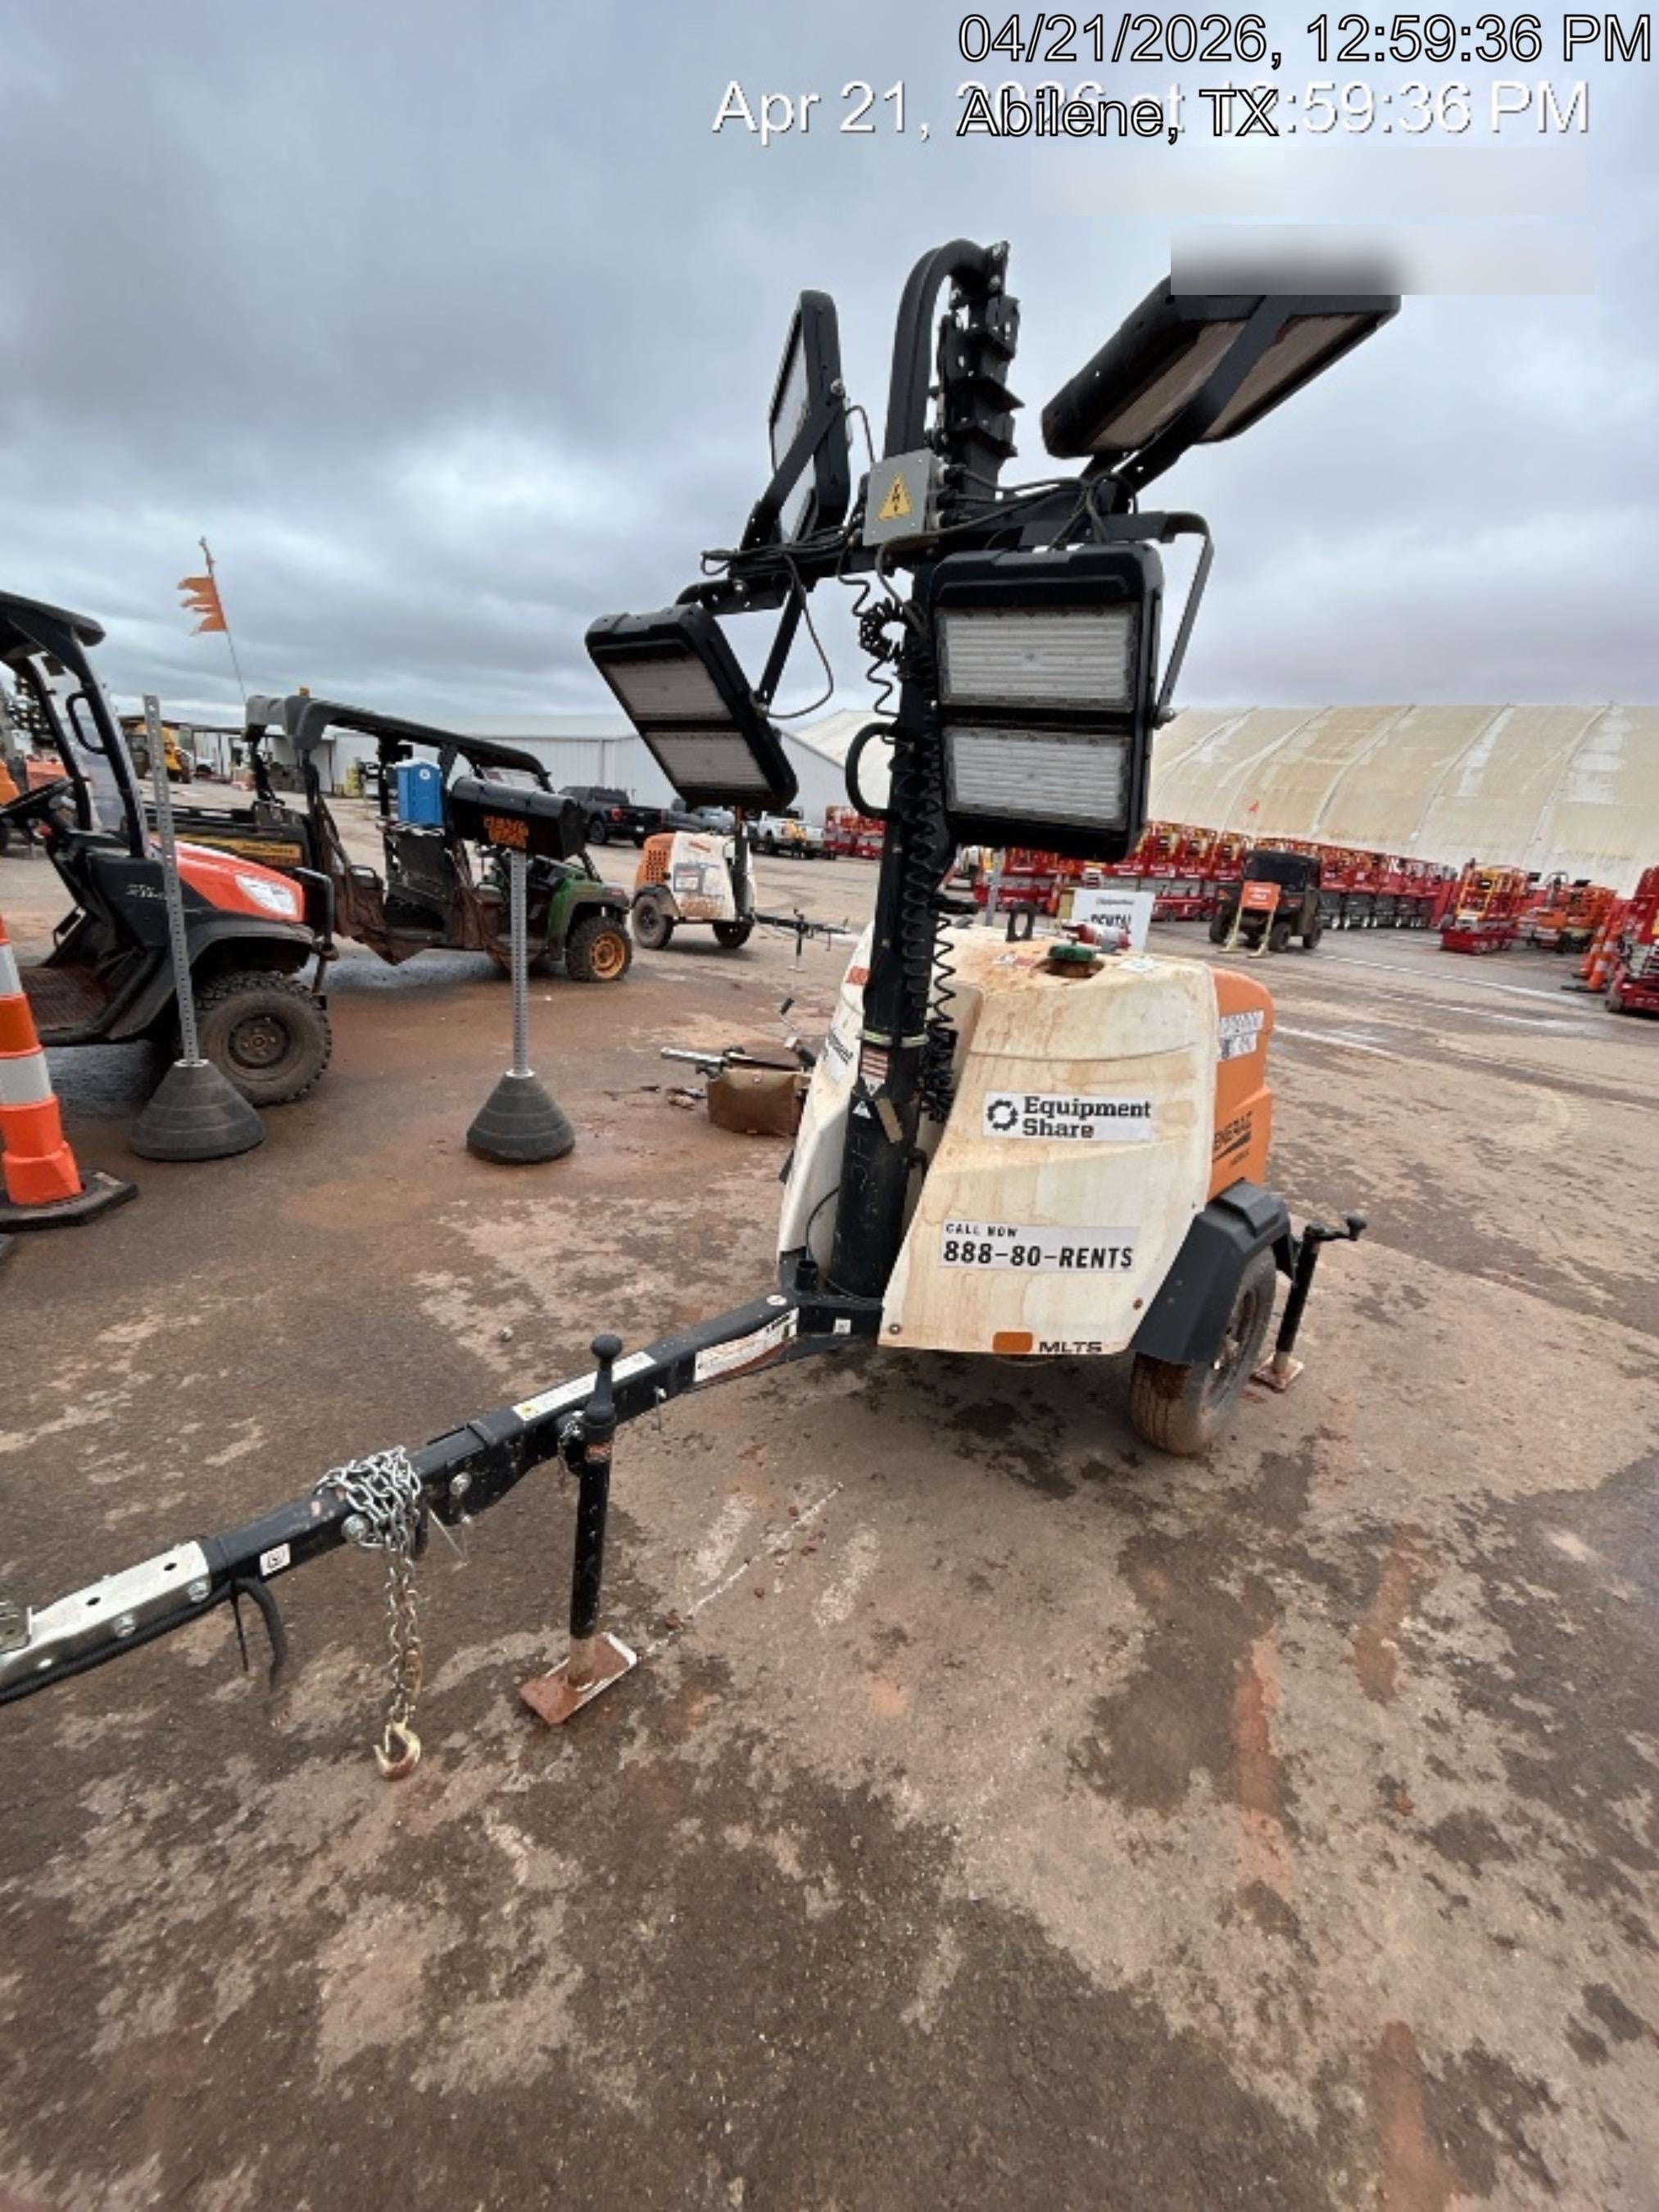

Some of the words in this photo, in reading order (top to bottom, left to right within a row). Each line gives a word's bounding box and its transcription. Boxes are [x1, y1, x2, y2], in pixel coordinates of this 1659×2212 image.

[1023, 1095, 1151, 1119] Equipment
[1022, 1118, 1094, 1138] Share
[945, 1223, 981, 1236] CALL
[987, 1226, 1018, 1237] NOW
[943, 1240, 1134, 1269] 888-80-RENTS
